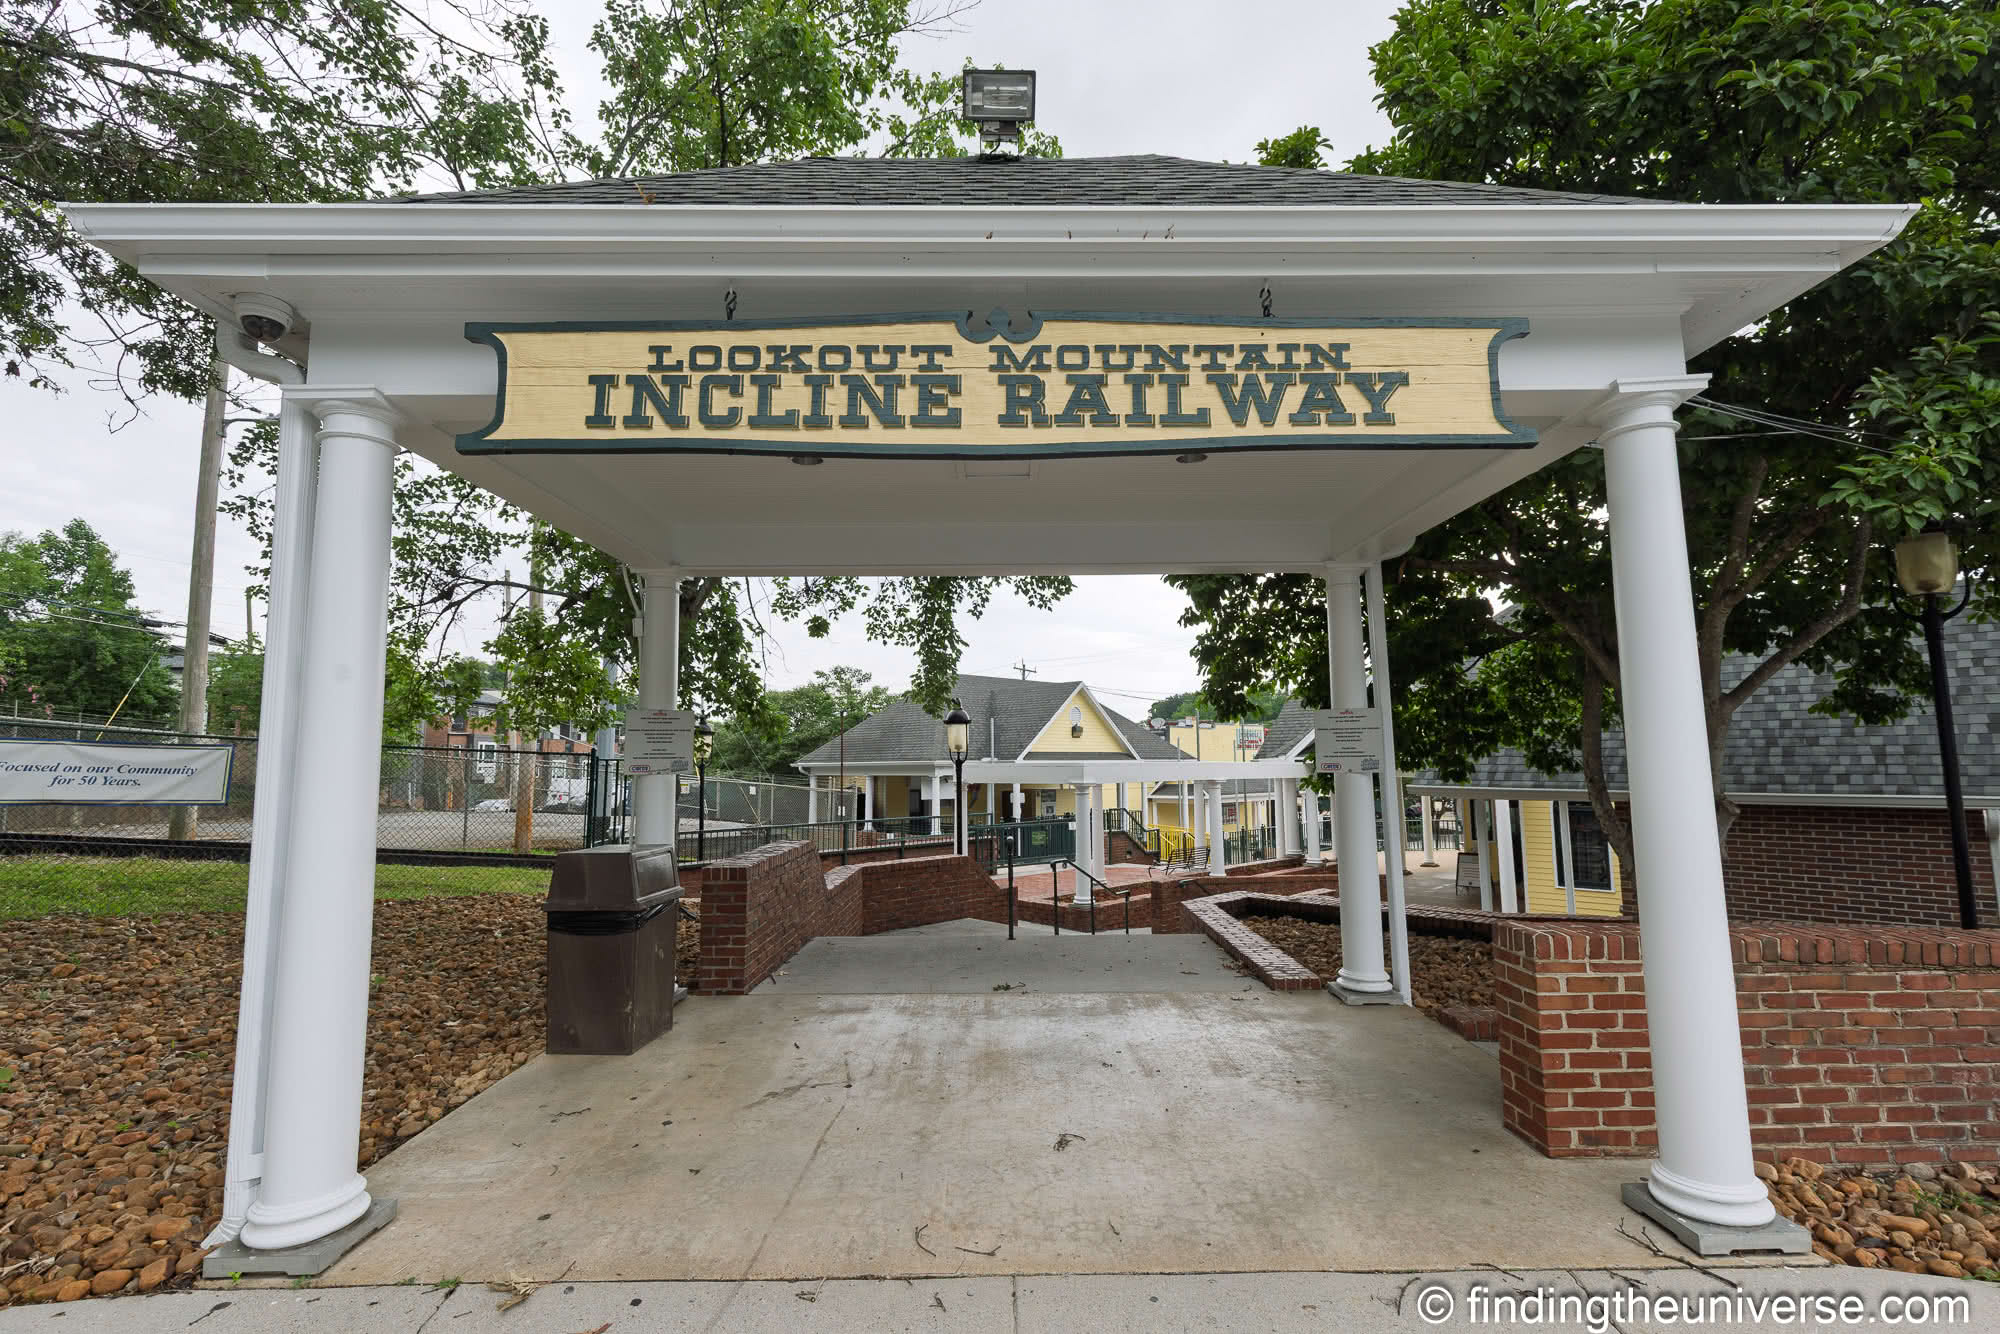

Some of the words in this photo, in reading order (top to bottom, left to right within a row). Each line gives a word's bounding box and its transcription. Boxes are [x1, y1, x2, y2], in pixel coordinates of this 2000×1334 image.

[647, 344, 953, 373] LOOKOUT
[989, 343, 1351, 372] MOUNTAIN
[585, 373, 963, 430] INCLINE
[998, 371, 1410, 428] RAILWAY
[62, 765, 83, 774] on
[86, 765, 114, 774] our
[116, 764, 198, 777] Community
[48, 775, 75, 788] for
[78, 775, 97, 786] 50
[101, 775, 141, 787] Years.
